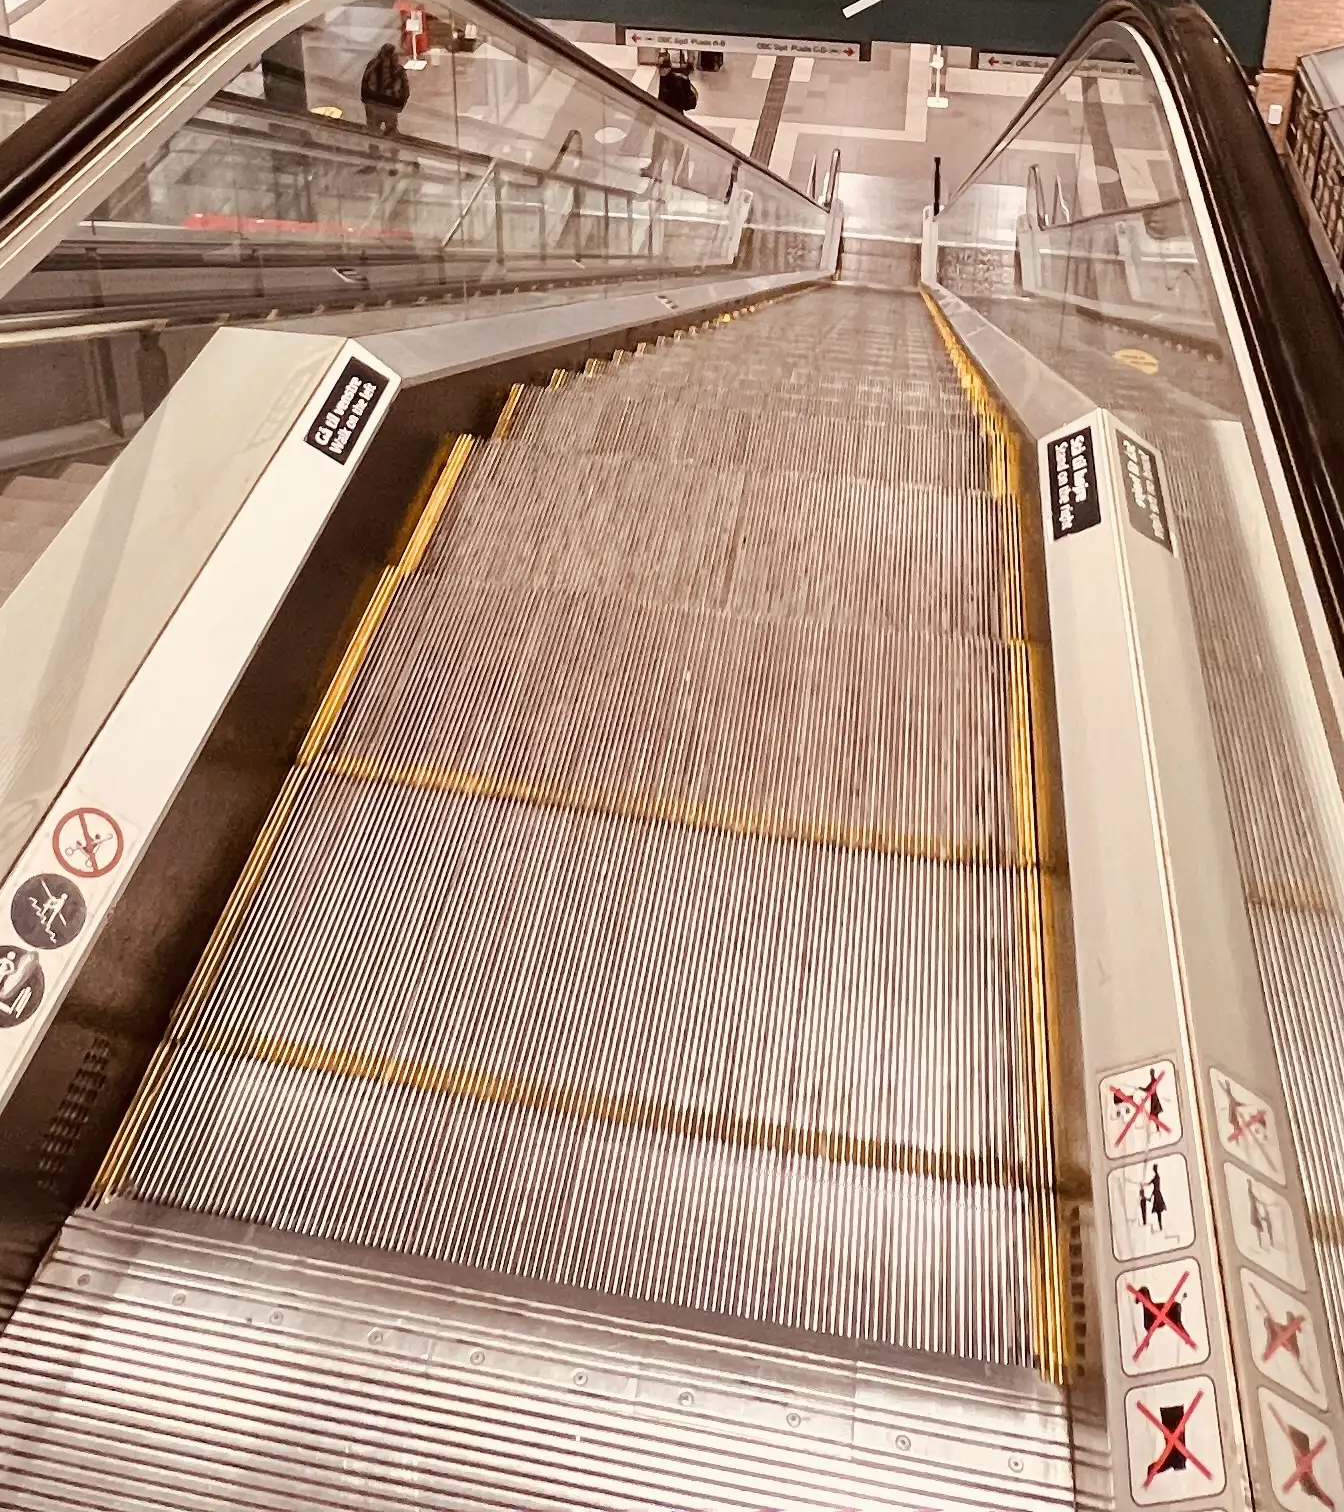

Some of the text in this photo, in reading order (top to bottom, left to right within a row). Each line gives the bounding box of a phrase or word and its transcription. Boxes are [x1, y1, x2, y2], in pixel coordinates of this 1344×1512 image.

[314, 426, 333, 444] Gå
[333, 376, 362, 414] venstre
[328, 382, 376, 453] Walk on the left
